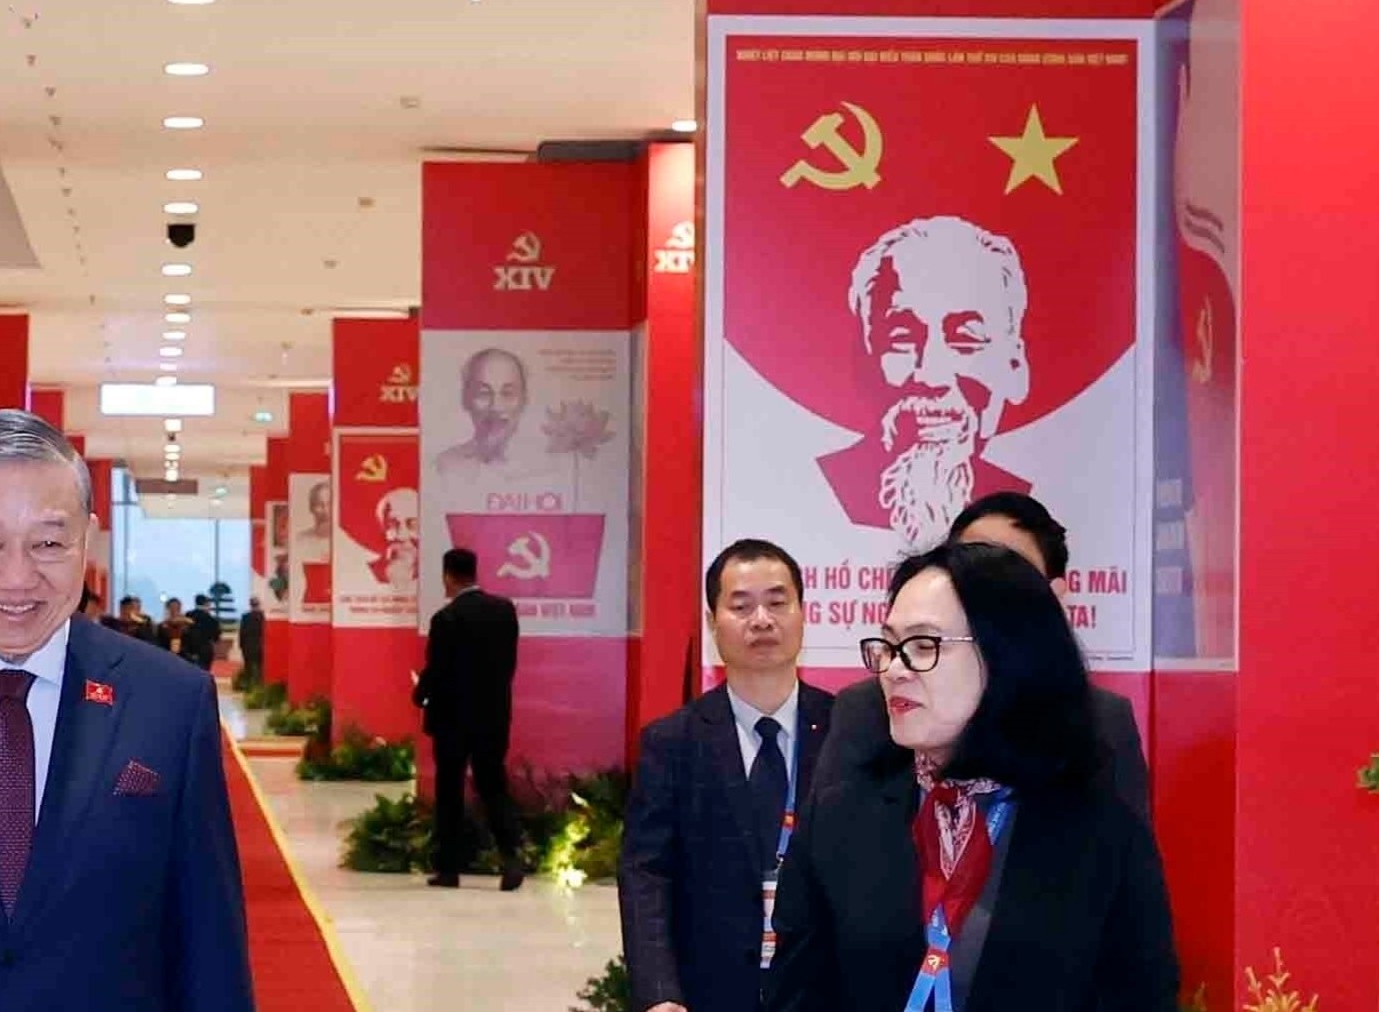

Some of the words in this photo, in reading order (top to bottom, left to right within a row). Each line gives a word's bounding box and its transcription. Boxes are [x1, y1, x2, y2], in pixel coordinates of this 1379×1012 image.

[493, 266, 556, 291] XIV
[1088, 566, 1127, 593] MÃI
[828, 600, 858, 630] SỰ
